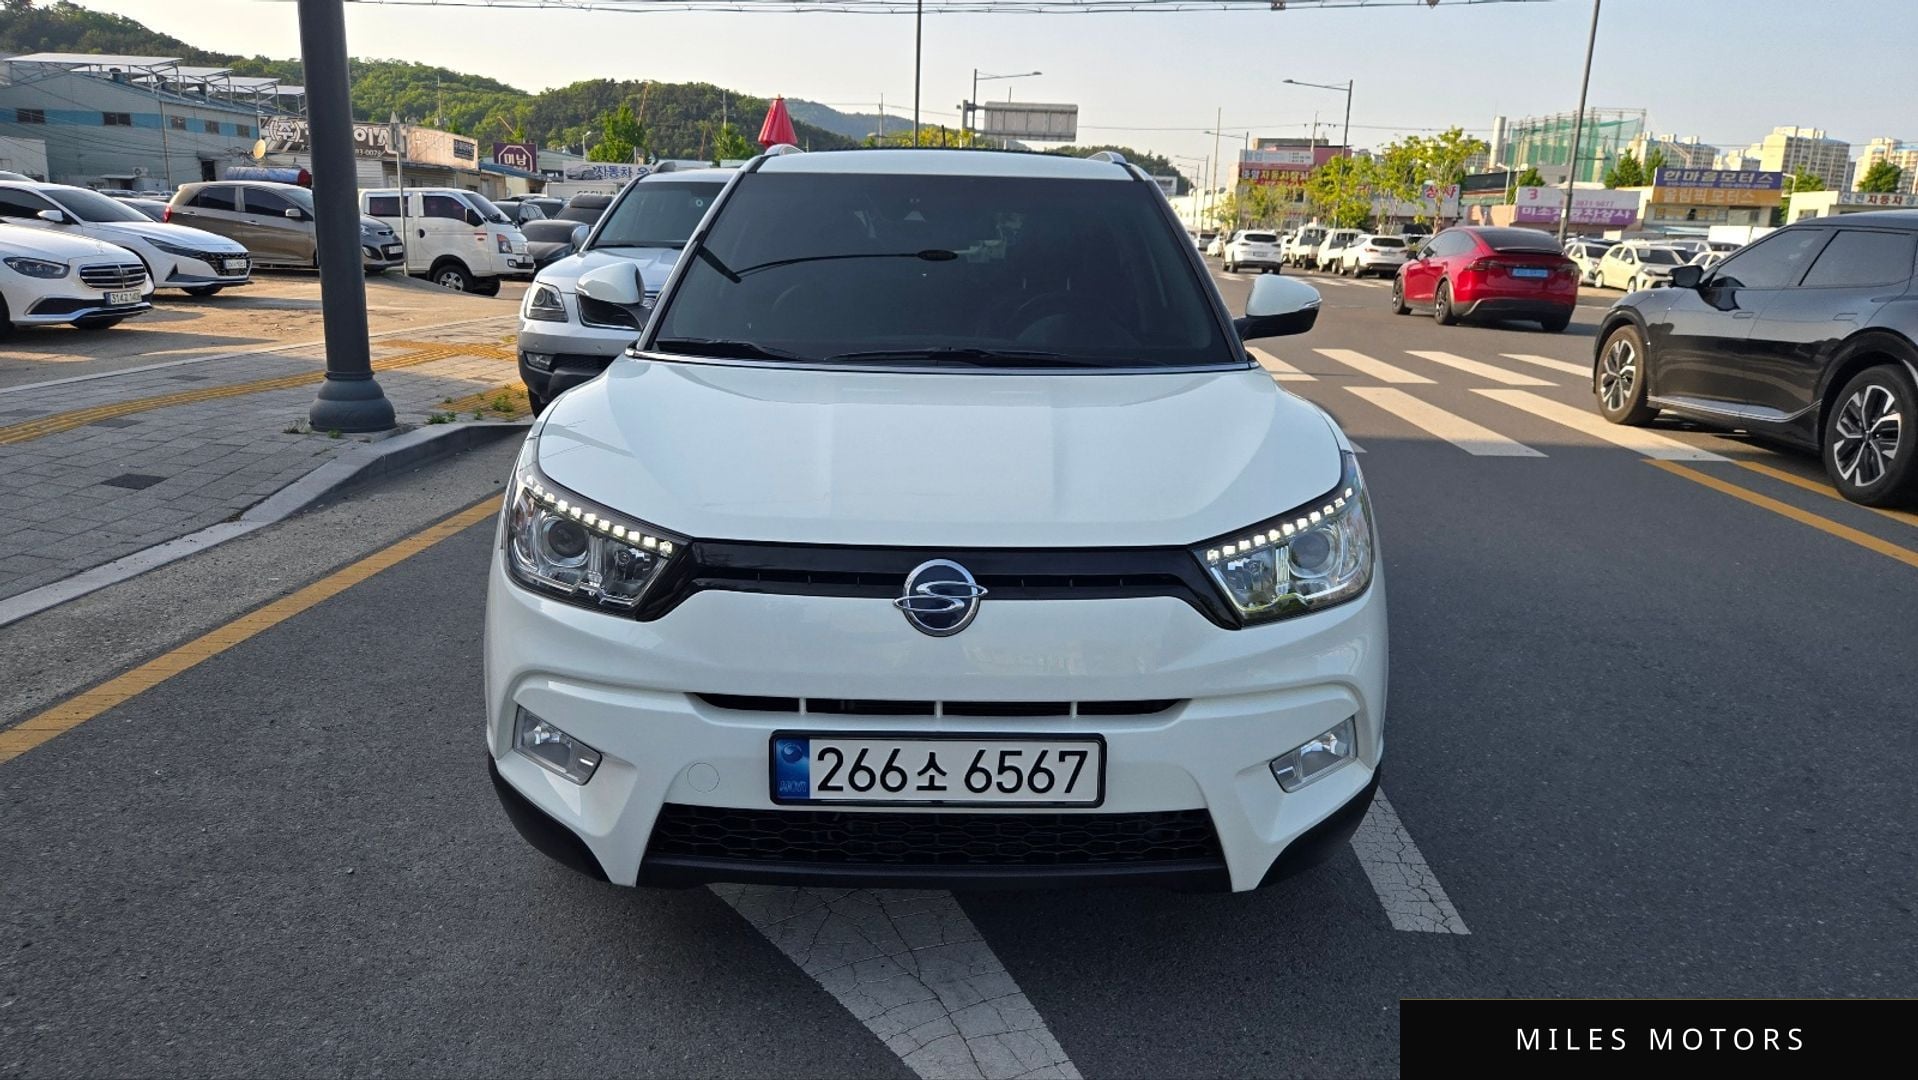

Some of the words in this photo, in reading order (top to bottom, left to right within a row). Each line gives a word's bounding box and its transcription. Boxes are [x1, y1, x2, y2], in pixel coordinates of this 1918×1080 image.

[504, 153, 527, 166] 미남
[593, 165, 632, 179] 자동차
[817, 747, 947, 792] 266소
[964, 749, 1089, 794] 6567
